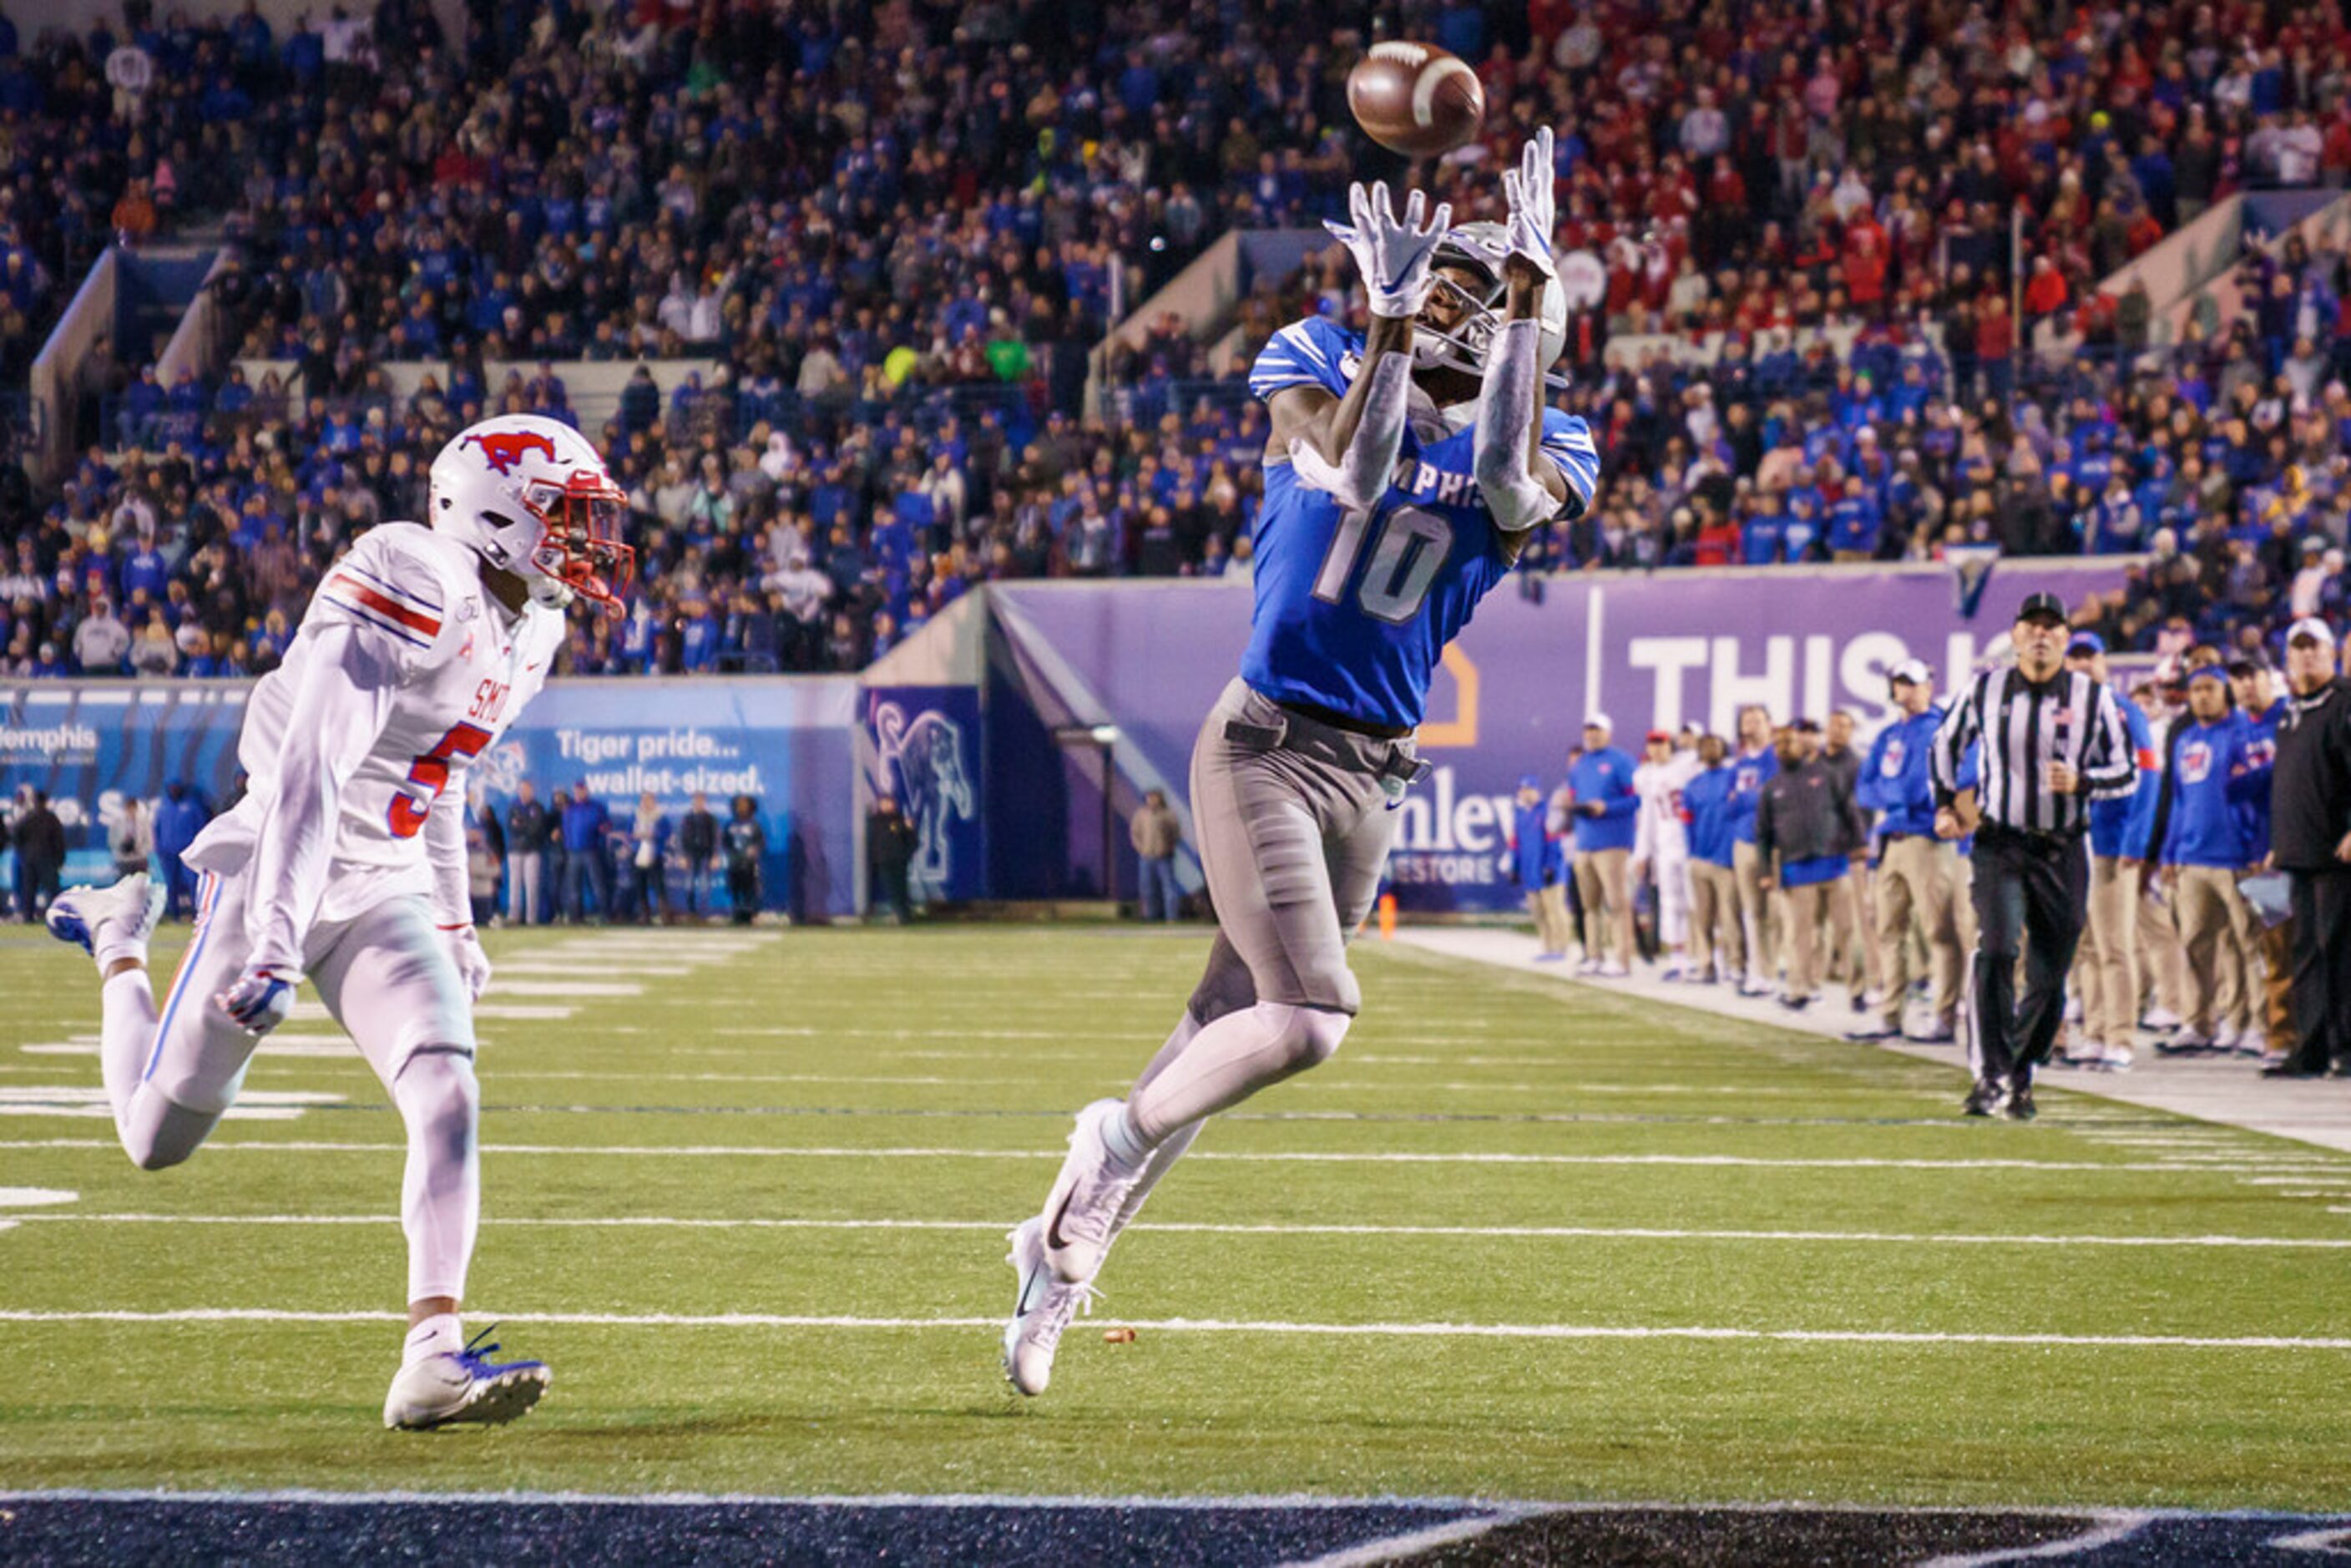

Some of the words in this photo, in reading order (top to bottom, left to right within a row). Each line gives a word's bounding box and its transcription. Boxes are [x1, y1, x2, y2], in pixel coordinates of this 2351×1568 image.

[1311, 501, 1454, 625] 10
[1630, 631, 1910, 756] THIS
[0, 723, 99, 755] emphis
[555, 728, 632, 764] Tiger
[638, 726, 740, 763] pride...
[387, 720, 494, 840] 5
[585, 765, 766, 794] wallet-sized.
[1383, 854, 1494, 885] ESTORE
